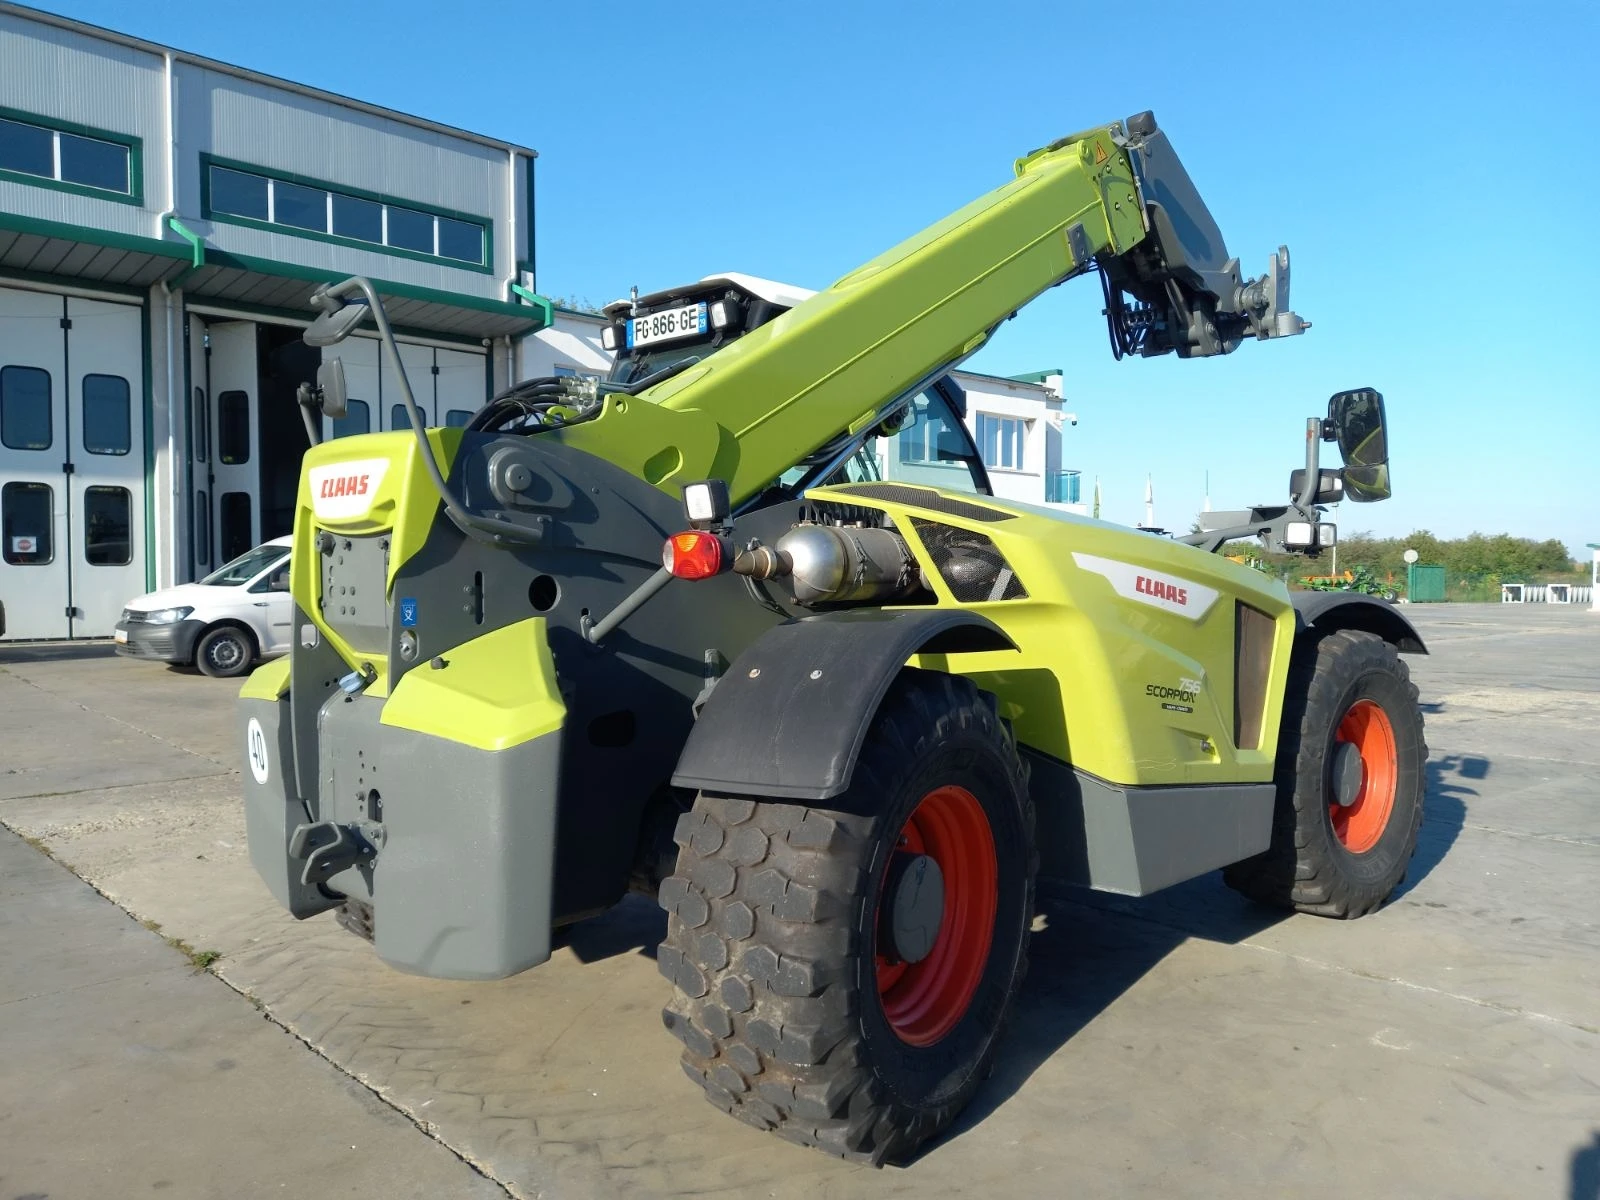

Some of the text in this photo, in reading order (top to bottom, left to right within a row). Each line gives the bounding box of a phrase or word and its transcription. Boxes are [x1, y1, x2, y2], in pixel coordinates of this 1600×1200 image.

[320, 474, 370, 499] CLAAS
[1135, 575, 1188, 606] CLAAS
[1145, 684, 1197, 704] SCORPION
[251, 728, 266, 771] 40
